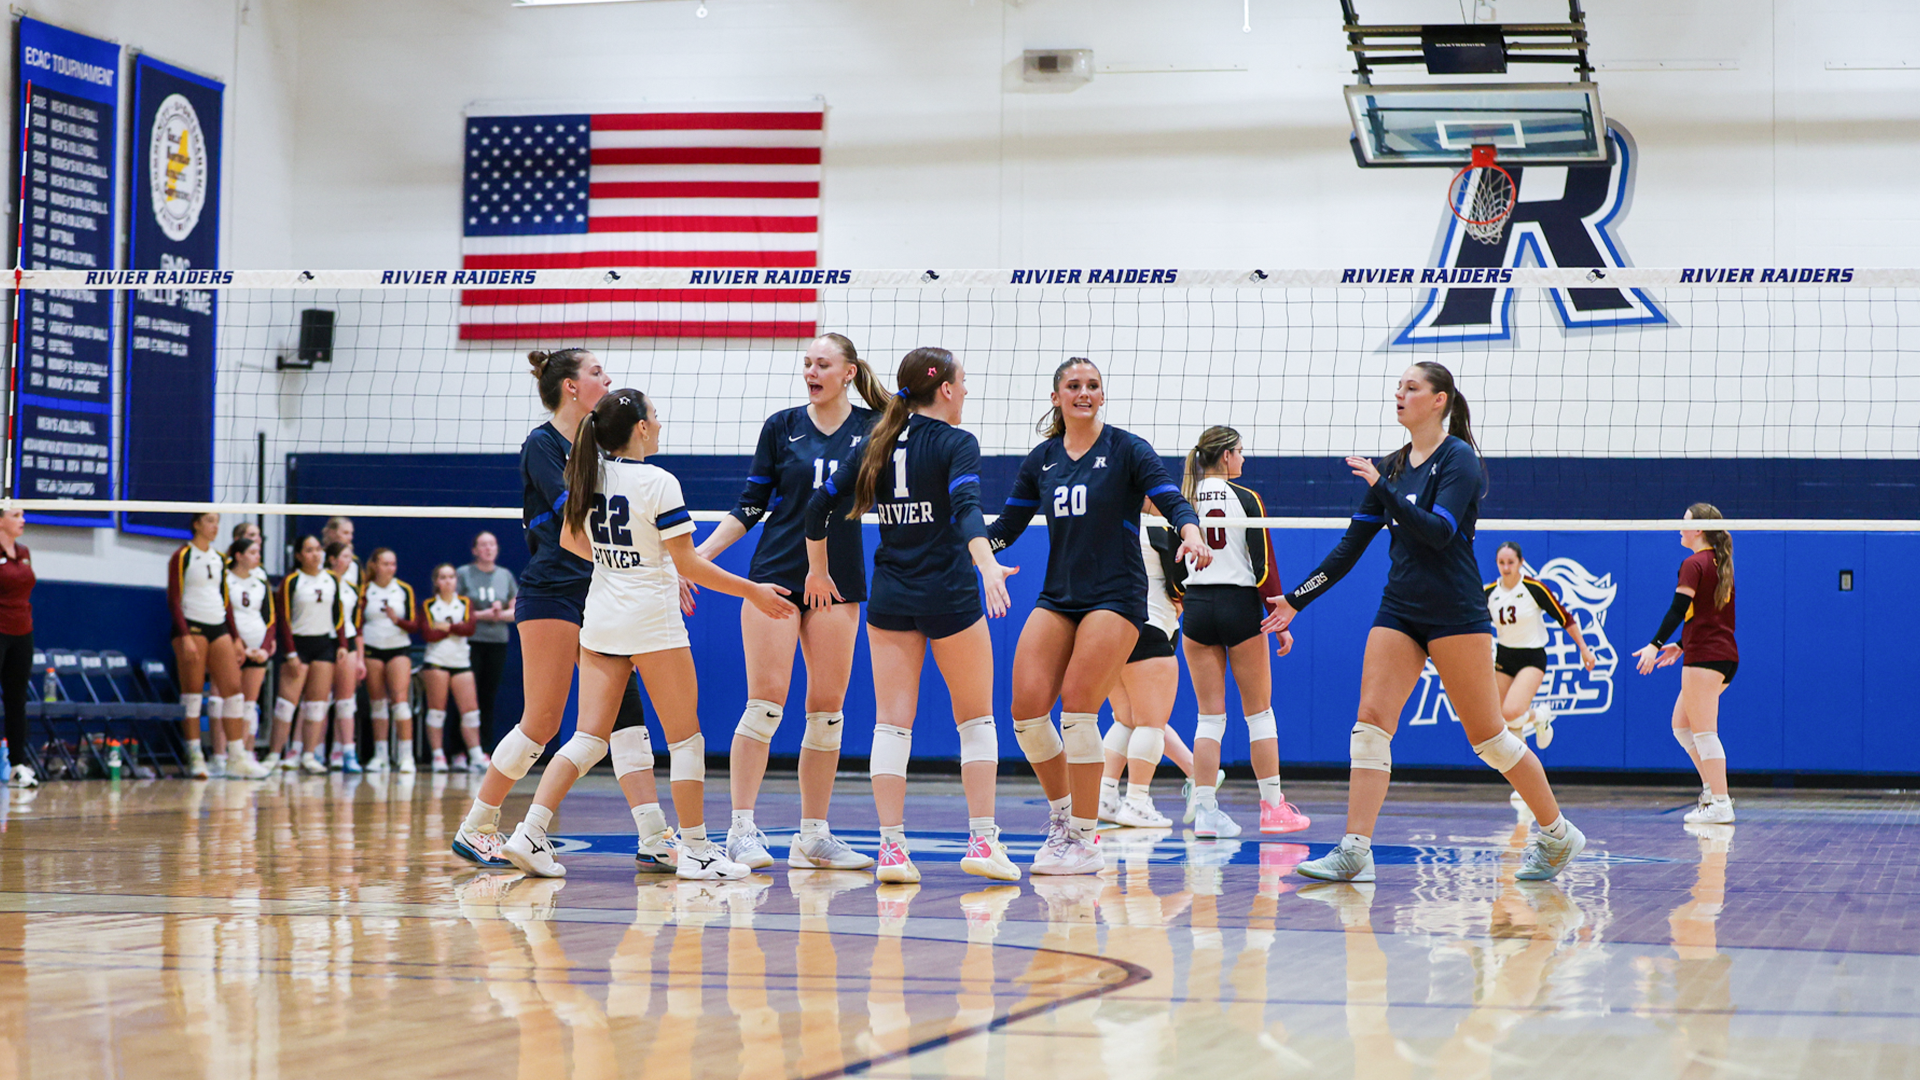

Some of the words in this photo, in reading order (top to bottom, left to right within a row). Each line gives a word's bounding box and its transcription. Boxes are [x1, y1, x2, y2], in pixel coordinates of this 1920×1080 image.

[25, 46, 51, 70] ECAC
[52, 54, 114, 87] TOURNAMENT
[86, 271, 148, 284] RIVIER
[152, 270, 234, 284] RAIDERS
[381, 270, 448, 285] RIVIER
[452, 270, 537, 285] RAIDERS
[690, 270, 759, 285] RIVIER
[763, 270, 852, 285] RAIDERS
[1010, 269, 1082, 284] RIVIER
[1086, 269, 1178, 284] RAIDERS
[1341, 269, 1415, 284] RIVIER
[1420, 269, 1513, 284] RAIDERS
[1680, 268, 1755, 283] RIVIER
[1759, 268, 1854, 283] RAIDERS
[1092, 456, 1108, 469] R
[812, 457, 839, 489] 11
[892, 447, 910, 499] 1
[1053, 484, 1087, 518] 20
[1199, 491, 1227, 502] DETS
[590, 493, 633, 547] 22
[877, 501, 934, 524] RIVIER
[1294, 571, 1329, 598] RAIDERS
[1499, 605, 1517, 626] 13
